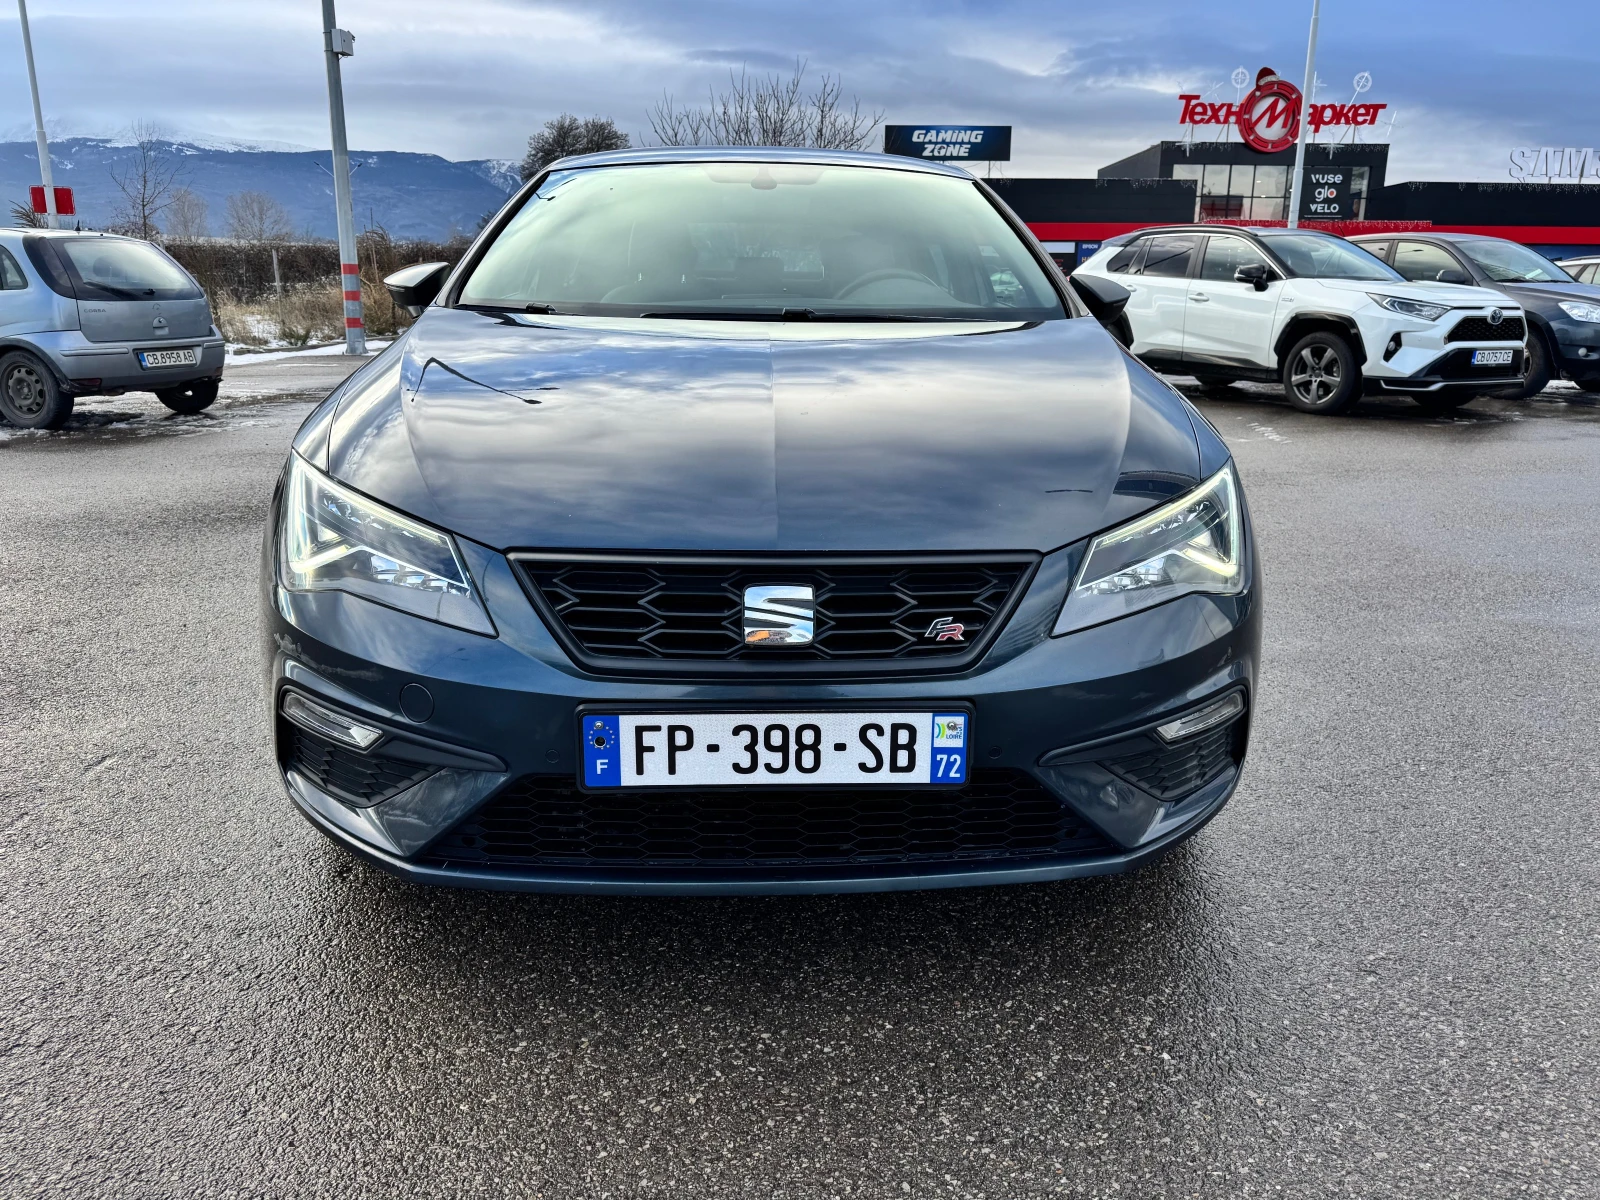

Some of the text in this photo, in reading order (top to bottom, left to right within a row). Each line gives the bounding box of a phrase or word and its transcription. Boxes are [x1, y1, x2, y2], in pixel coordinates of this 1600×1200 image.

[911, 130, 984, 142] GAMING
[921, 144, 971, 157] ZONE
[1508, 145, 1600, 179] SAM
[1315, 185, 1336, 201] glo
[1310, 204, 1339, 212] VELO
[596, 759, 609, 775] F
[936, 753, 962, 778] 72
